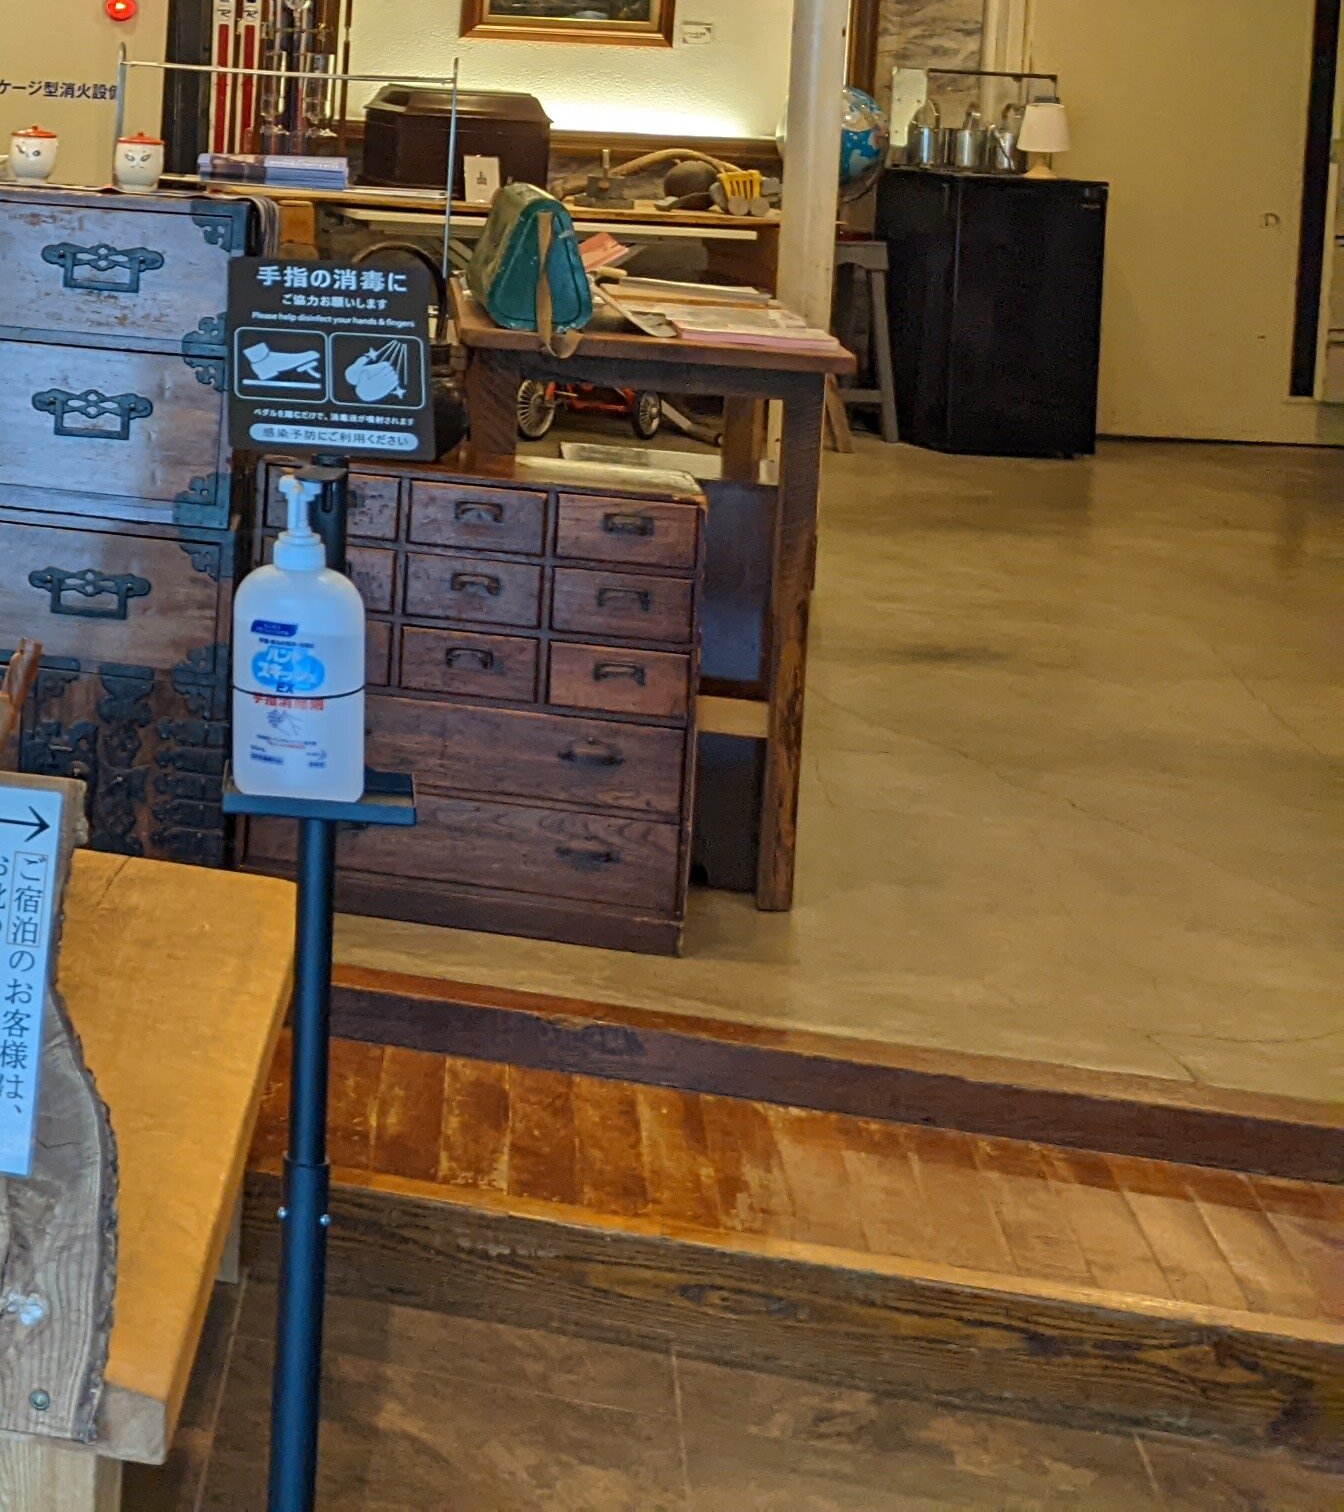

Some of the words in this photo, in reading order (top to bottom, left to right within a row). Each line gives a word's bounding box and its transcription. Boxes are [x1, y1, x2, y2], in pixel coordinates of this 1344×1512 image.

[256, 265, 408, 293] 手指の消毒に
[281, 294, 388, 310] ご協力お願いします
[278, 313, 297, 324] help
[332, 317, 352, 326] your
[352, 316, 377, 326] hands
[262, 425, 409, 448] 感染予防にご利用ください
